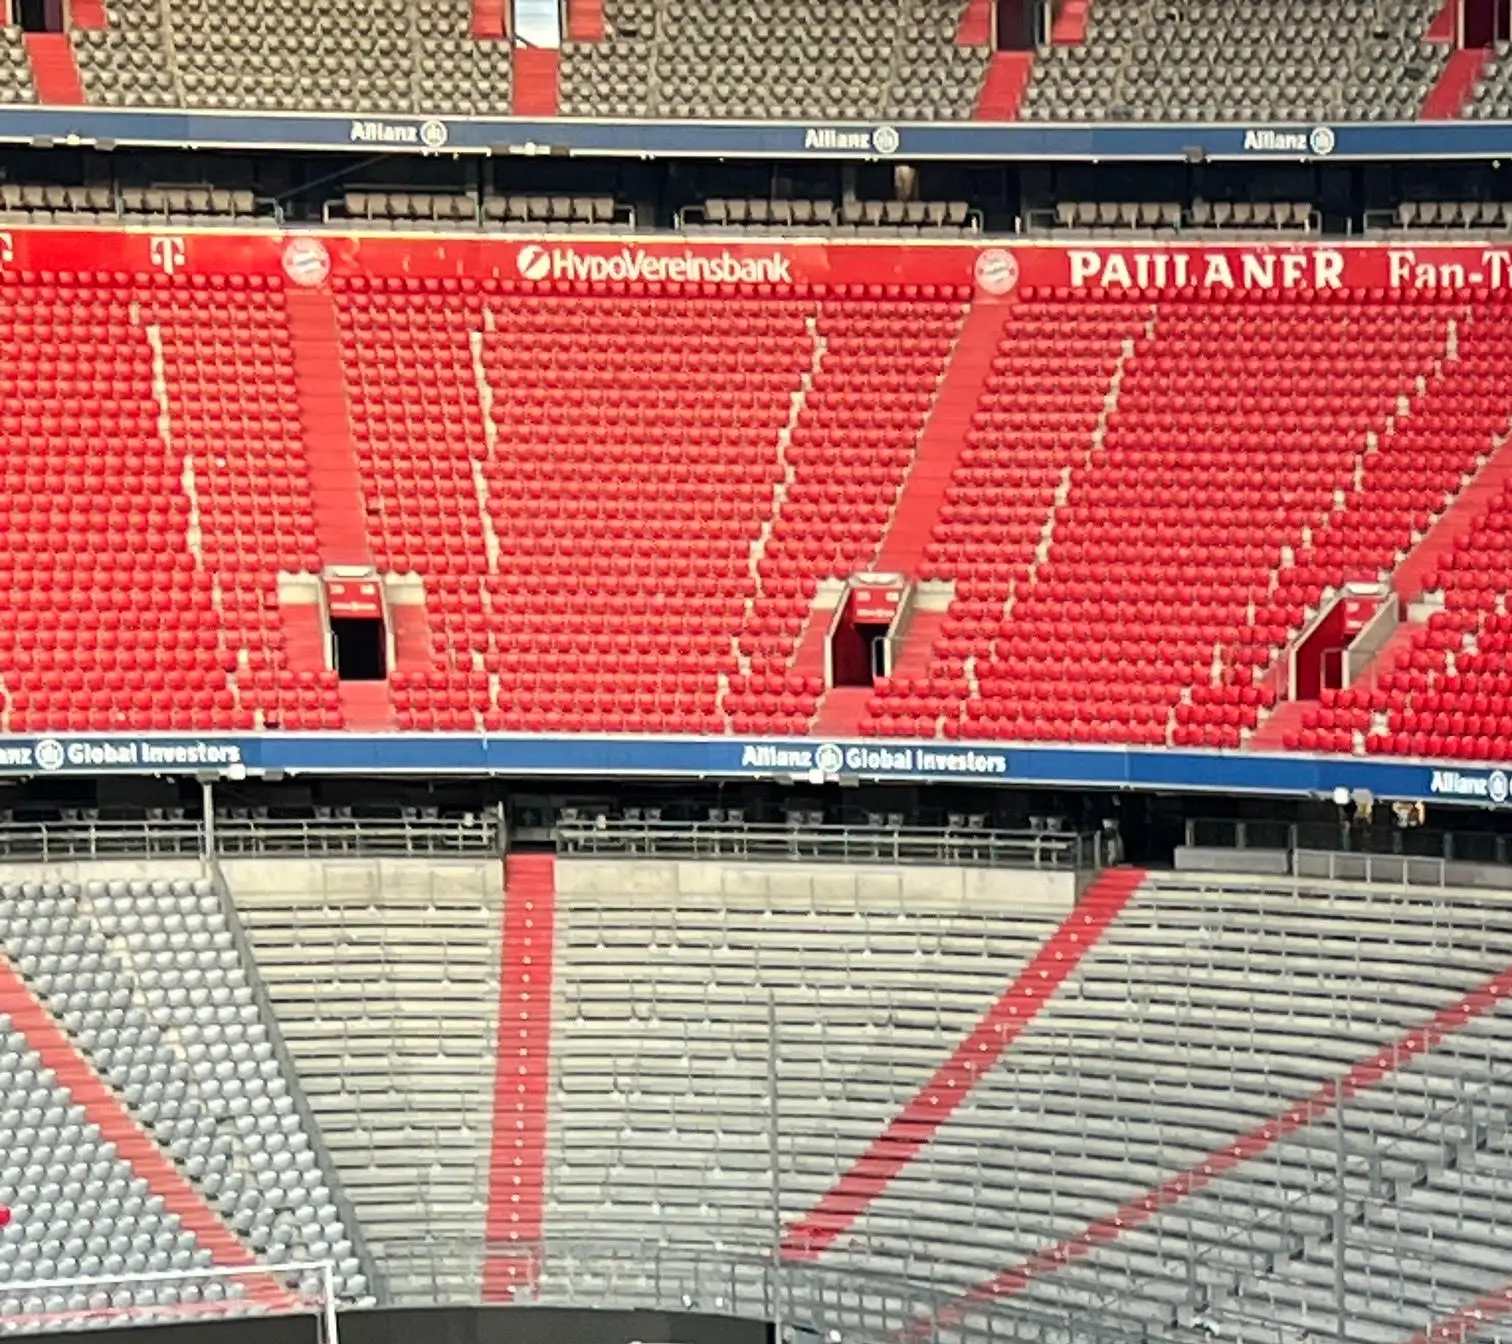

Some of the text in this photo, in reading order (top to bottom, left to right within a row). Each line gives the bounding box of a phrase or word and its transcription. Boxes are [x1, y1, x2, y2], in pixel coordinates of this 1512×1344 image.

[350, 120, 418, 142] Allianz
[805, 128, 870, 149] Allianz
[1244, 130, 1306, 151] Allianz
[553, 252, 792, 284] HypoVereinsbank
[67, 742, 241, 765] Global Investors
[742, 745, 1006, 774] Allianz Global Investors
[1431, 770, 1487, 796] Allianz
